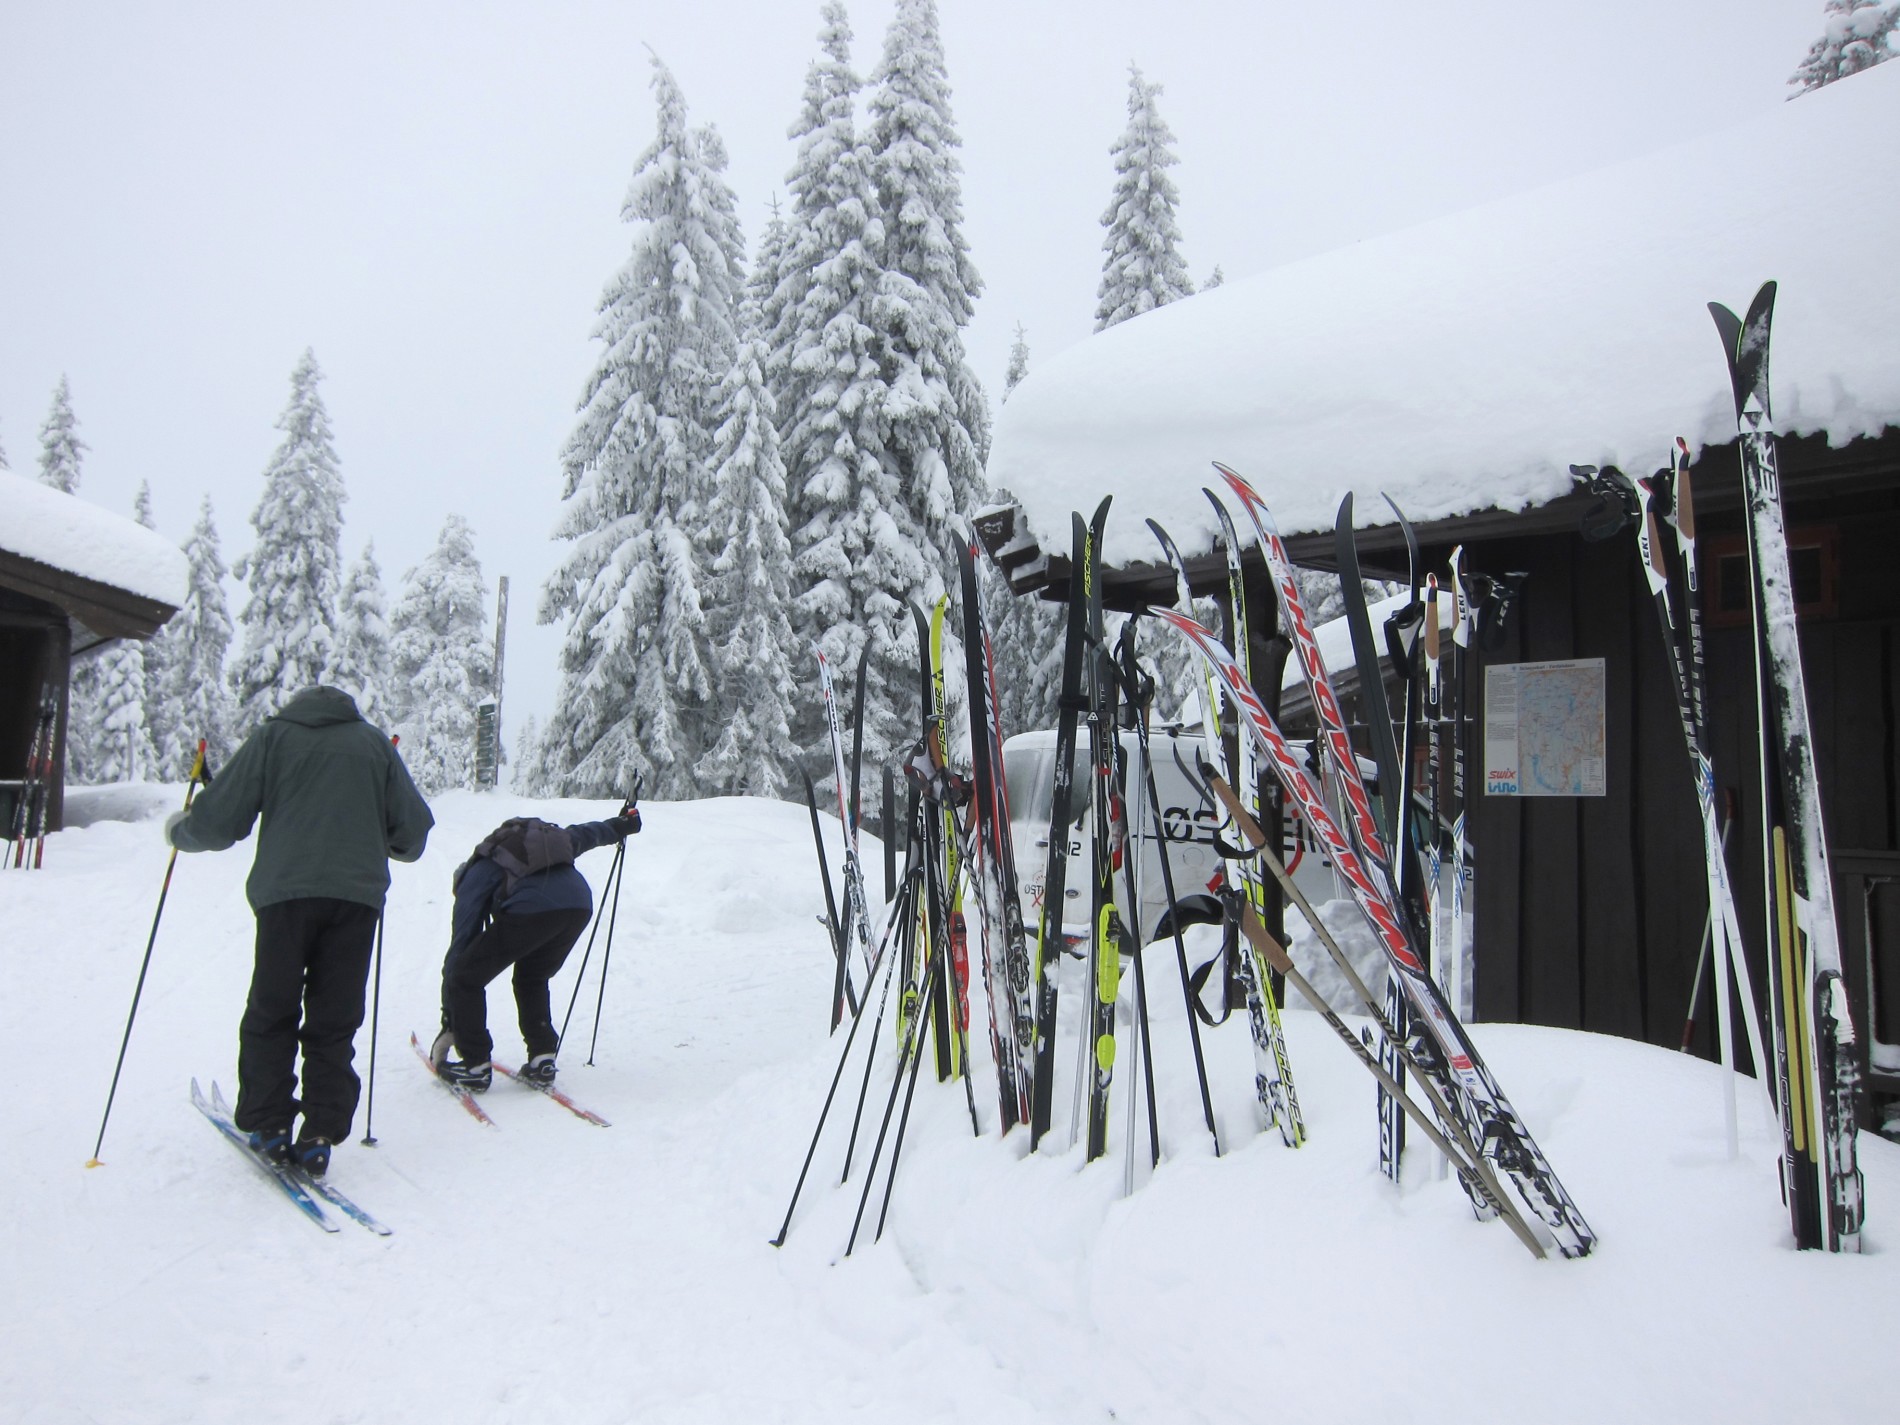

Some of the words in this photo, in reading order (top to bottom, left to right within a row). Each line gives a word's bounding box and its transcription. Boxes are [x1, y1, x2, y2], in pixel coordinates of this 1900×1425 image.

[1084, 534, 1094, 599] FISCHER
[1641, 536, 1651, 567] LEKI
[1458, 594, 1467, 621] LEKI
[1690, 608, 1704, 664] LEKI
[827, 675, 838, 732] MADSHUS
[1268, 533, 1388, 861] MADSHUS
[1429, 719, 1440, 767] LEKI
[1679, 705, 1700, 759] LEKI
[1454, 748, 1464, 798] LEKI
[1219, 663, 1426, 973] MADSHUS
[1273, 1022, 1303, 1125] FISCHER
[1776, 1026, 1797, 1191] AIRCORE
